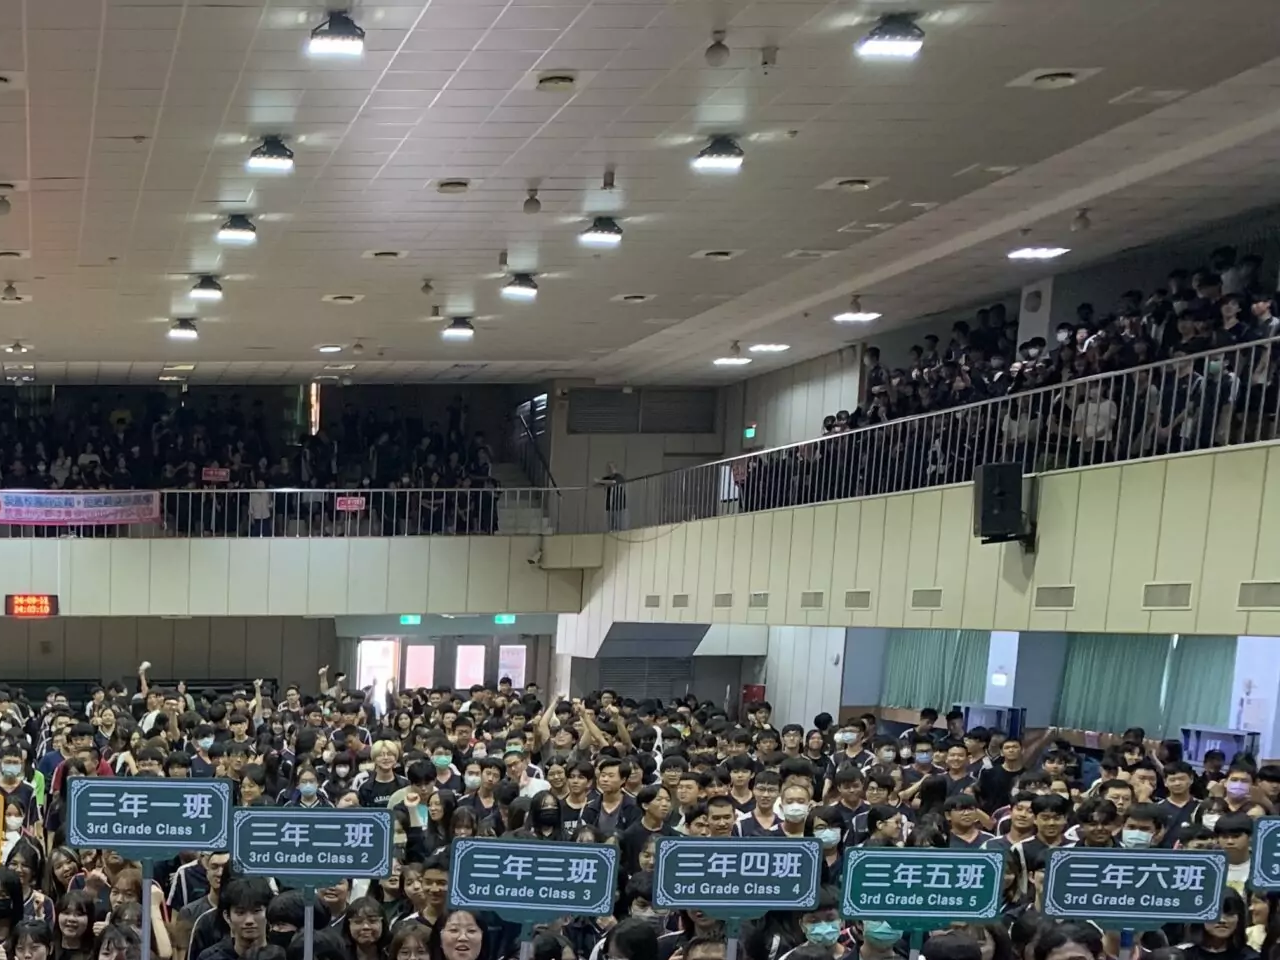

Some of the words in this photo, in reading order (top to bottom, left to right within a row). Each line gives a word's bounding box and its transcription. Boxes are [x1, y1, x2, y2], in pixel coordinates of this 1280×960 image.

[87, 791, 213, 819] 三年一班
[87, 823, 108, 834] 3rd
[112, 823, 152, 835] Grade
[156, 824, 192, 836] Class
[200, 824, 206, 835] 1
[250, 822, 374, 848] 三年二班
[249, 852, 270, 863] 3rd
[274, 852, 313, 864] Grade
[317, 852, 354, 864] Class
[361, 852, 369, 864] 2
[470, 853, 598, 884] 三年三班
[675, 851, 802, 879] 三年四班
[861, 863, 985, 890] 三年五班
[1066, 863, 1206, 891] 三年六班
[468, 883, 491, 896] 3rd
[494, 884, 535, 897] Grade
[539, 886, 576, 900] Class
[583, 889, 591, 900] 3
[674, 883, 696, 894] 3rd
[700, 883, 740, 895] Grade
[744, 883, 780, 895] Class
[792, 883, 800, 894] 4
[859, 893, 882, 905] 3rd
[885, 893, 923, 906] Grade
[927, 894, 963, 907] Class
[969, 895, 977, 907] 5
[1064, 893, 1087, 905] 3rd
[1091, 894, 1134, 907] Grade
[1140, 894, 1180, 907] Class
[1194, 894, 1203, 906] 6
